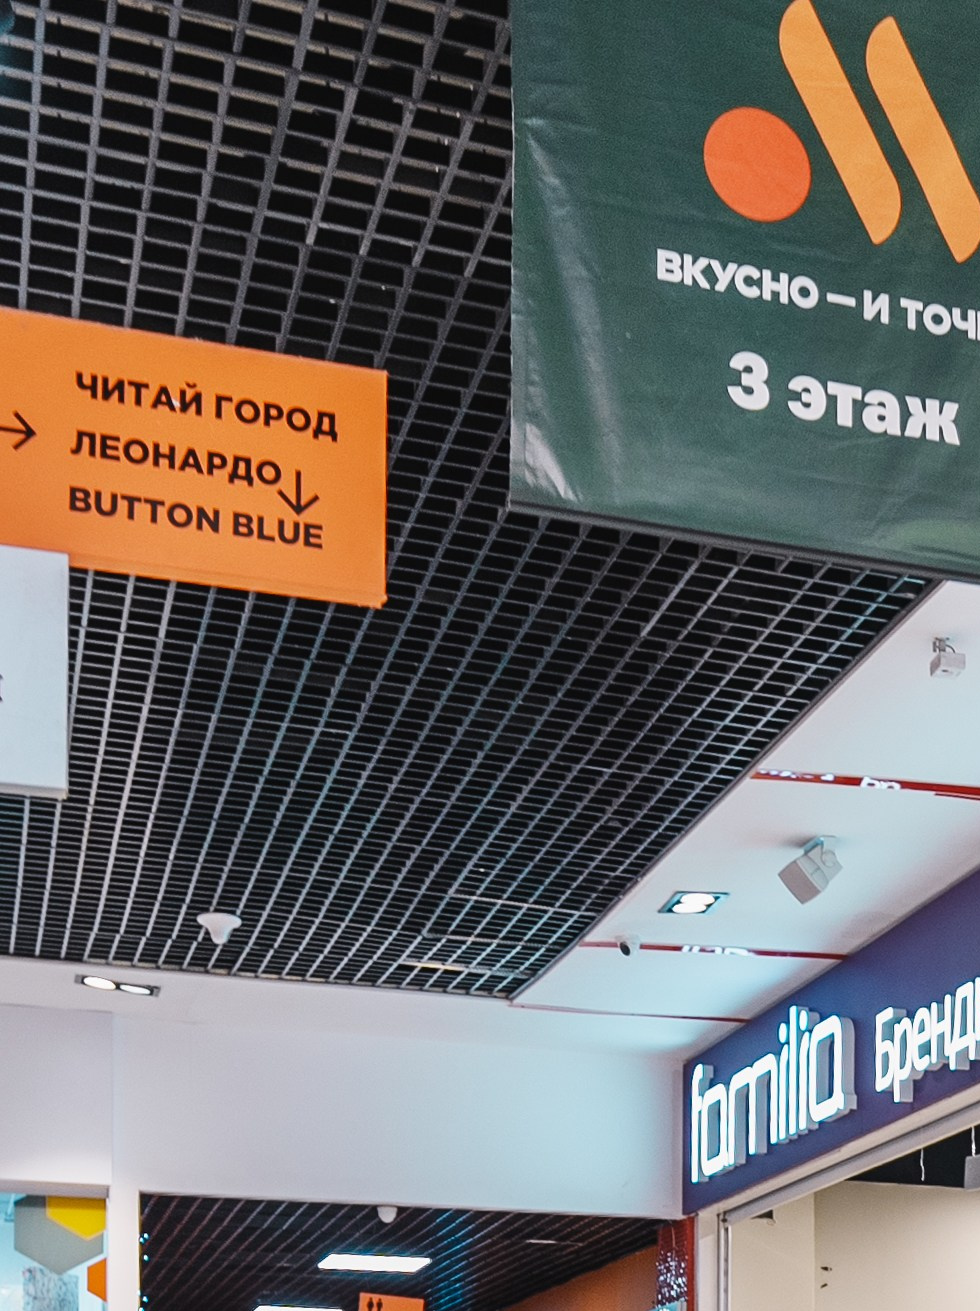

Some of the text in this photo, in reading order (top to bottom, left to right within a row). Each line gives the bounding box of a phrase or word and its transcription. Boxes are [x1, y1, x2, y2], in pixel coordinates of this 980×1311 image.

[656, 248, 818, 309] ВКУСНО
[75, 370, 339, 442] ЧИТАЙ ГОРОД
[726, 350, 960, 446] 3 этаж
[70, 429, 282, 487] ЛЕОНАРДО
[68, 486, 324, 550] BUTTON BLUE
[691, 1005, 848, 1184] familia
